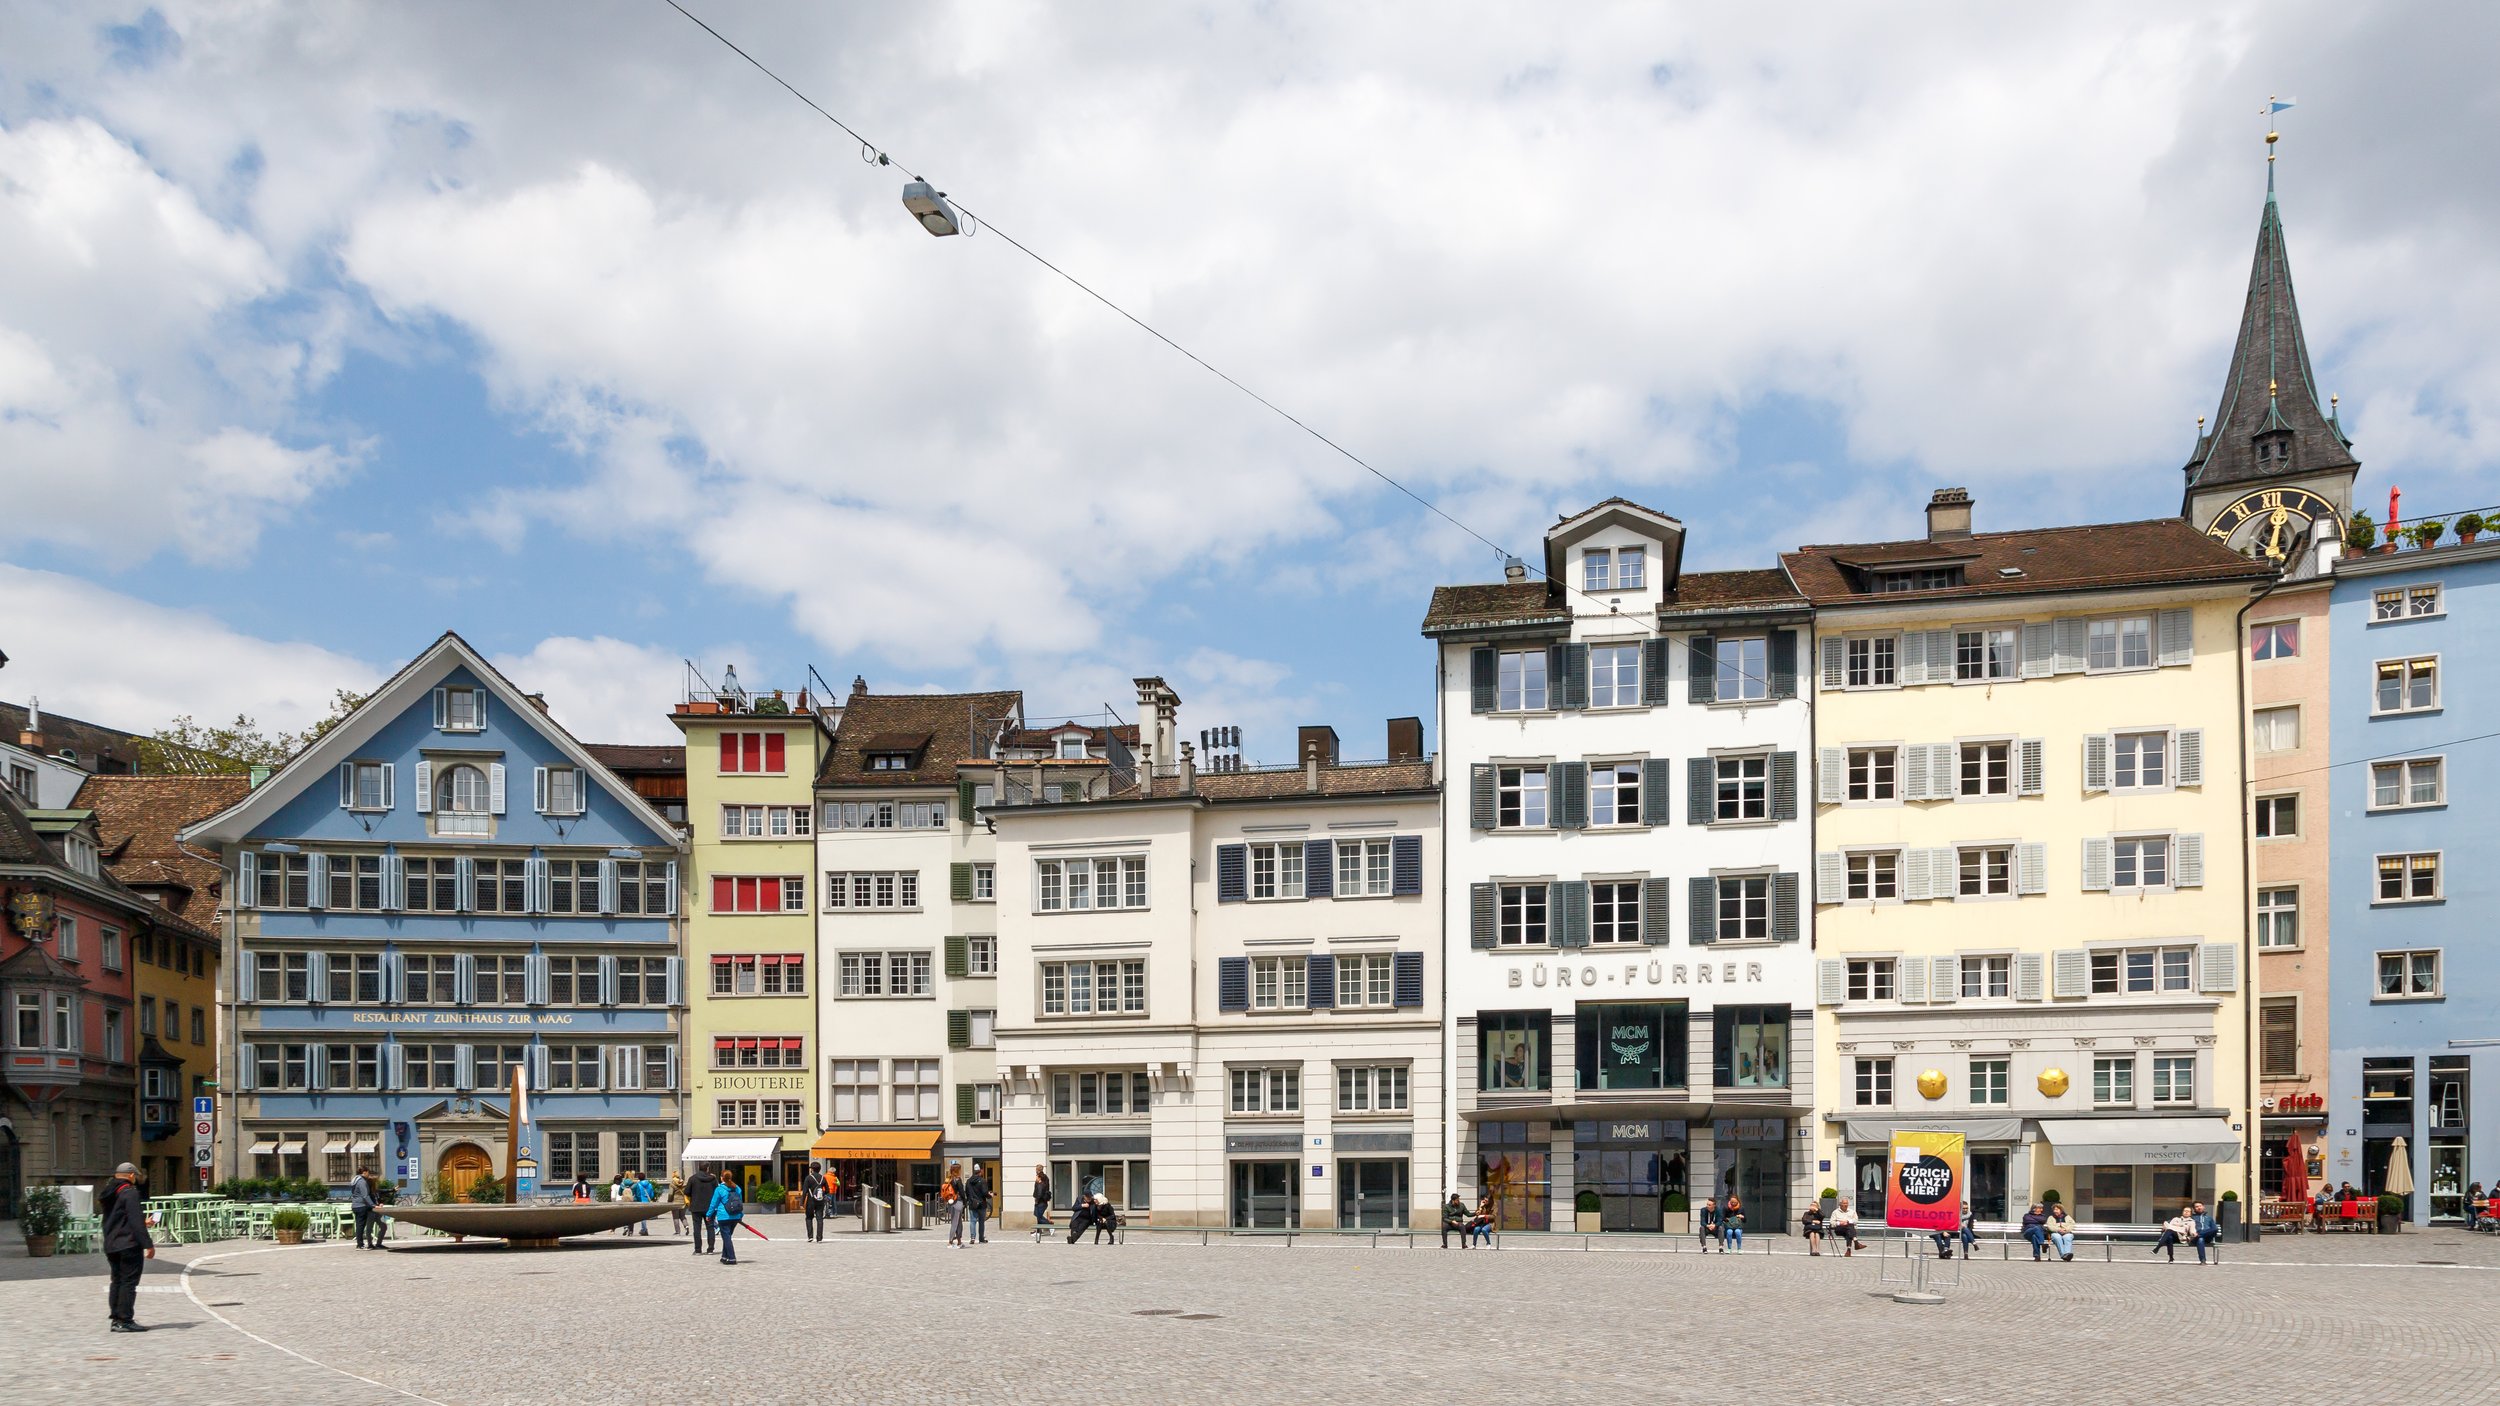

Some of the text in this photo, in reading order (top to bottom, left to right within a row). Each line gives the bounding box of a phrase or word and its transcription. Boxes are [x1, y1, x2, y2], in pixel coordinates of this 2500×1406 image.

[2261, 492, 2282, 508] XII
[2231, 502, 2251, 521] XI
[353, 1013, 573, 1024] RESTAURANT ZUNFTHAUS ZUR WAAG
[1612, 1025, 1649, 1039] MCM
[714, 1077, 805, 1089] BIJOUTERIE
[2279, 1093, 2324, 1108] club
[1612, 1124, 1649, 1138] MCM
[1721, 1125, 1776, 1137] AQUILA
[2144, 1151, 2187, 1159] messerer
[1902, 1166, 1950, 1178] ZÜRICH
[1908, 1177, 1950, 1187] TANZT
[1905, 1185, 1939, 1195] HIER!
[1894, 1209, 1953, 1220] SPIELORT
